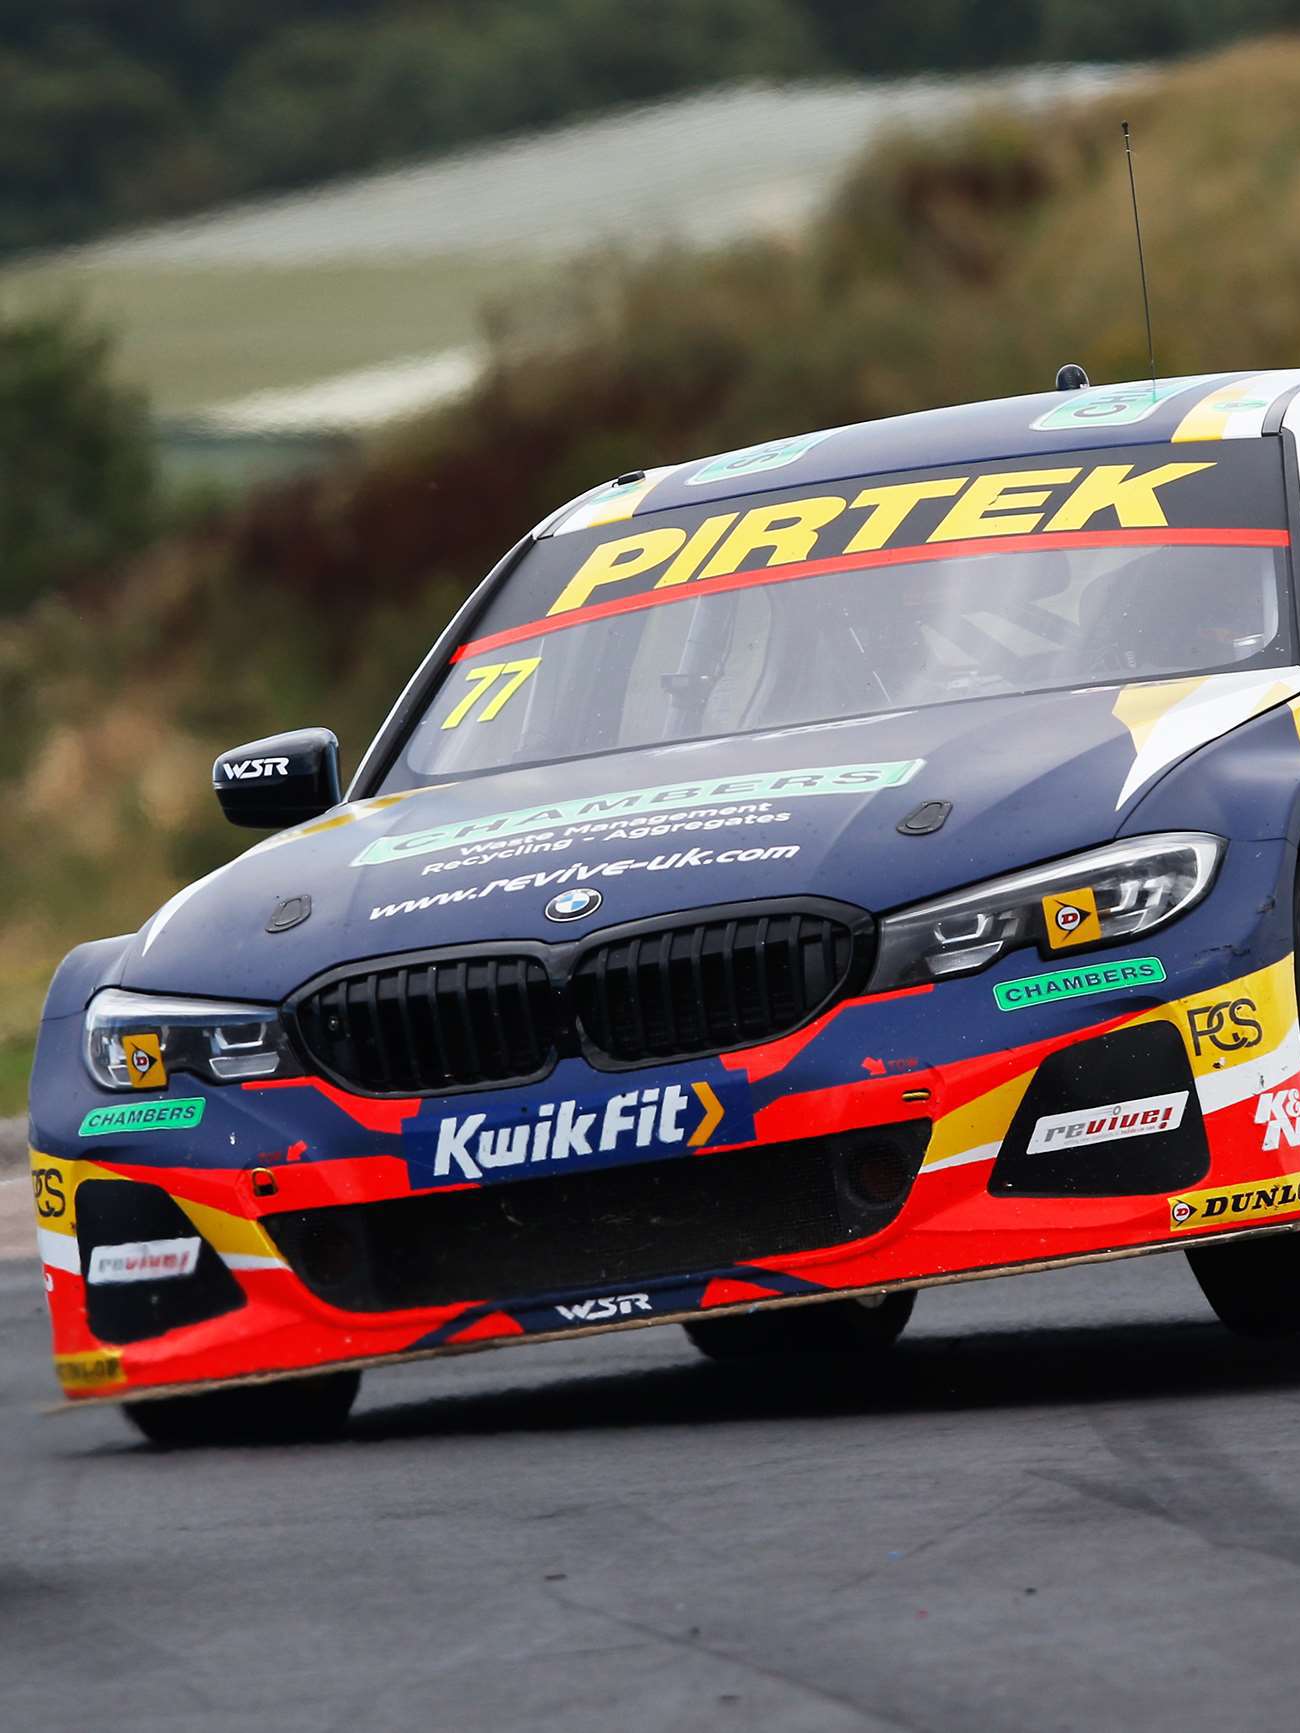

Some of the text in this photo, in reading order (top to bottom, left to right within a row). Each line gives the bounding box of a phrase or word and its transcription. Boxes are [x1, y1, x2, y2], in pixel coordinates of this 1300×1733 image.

[546, 462, 1217, 617] PIRTEK
[440, 656, 542, 731] 77
[222, 757, 289, 779] WSR
[391, 769, 885, 854] CHAMBERS
[459, 802, 773, 856] Waste Management
[420, 836, 573, 877] Recycling
[604, 812, 792, 842] Aggregates
[368, 844, 801, 921] www.revive-uk.com
[1004, 963, 1155, 1003] CHAMBERS
[88, 1105, 196, 1127] CHAMBERS
[554, 1293, 653, 1320] WSR
